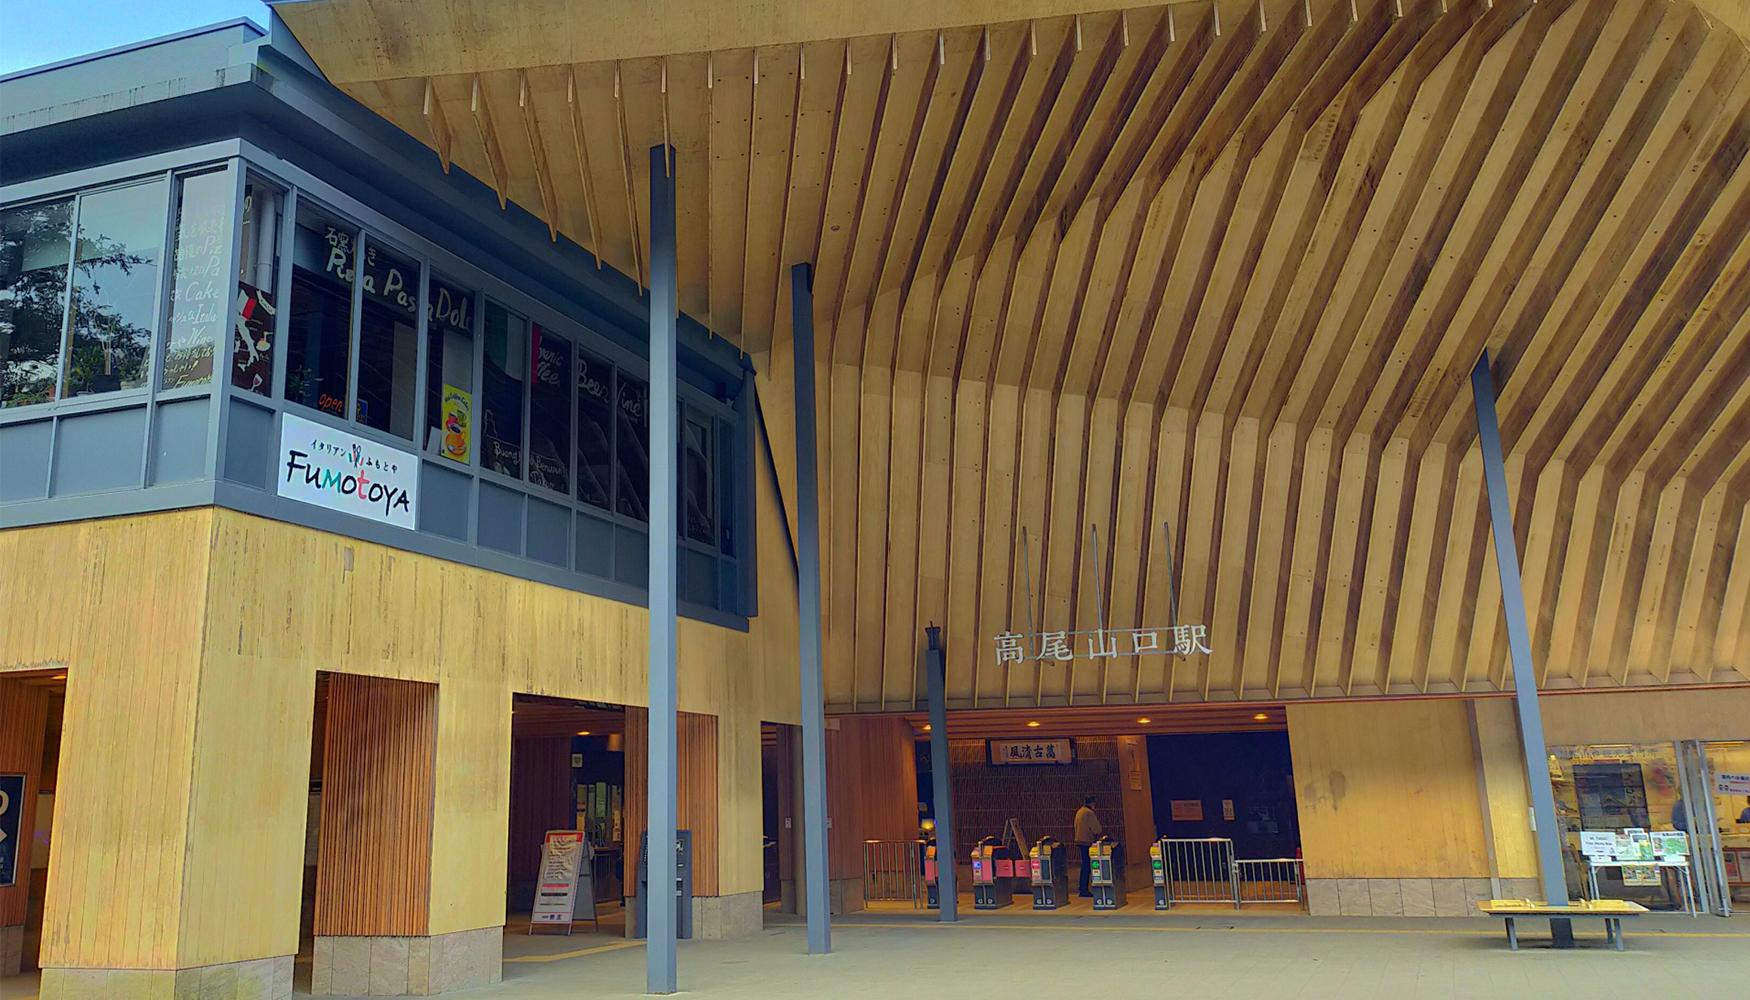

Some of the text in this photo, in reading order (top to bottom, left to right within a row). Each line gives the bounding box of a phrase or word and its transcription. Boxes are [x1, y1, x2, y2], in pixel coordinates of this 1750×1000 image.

[310, 439, 398, 474] イタリアン ふもとや
[993, 624, 1214, 666] 高尾山口駅
